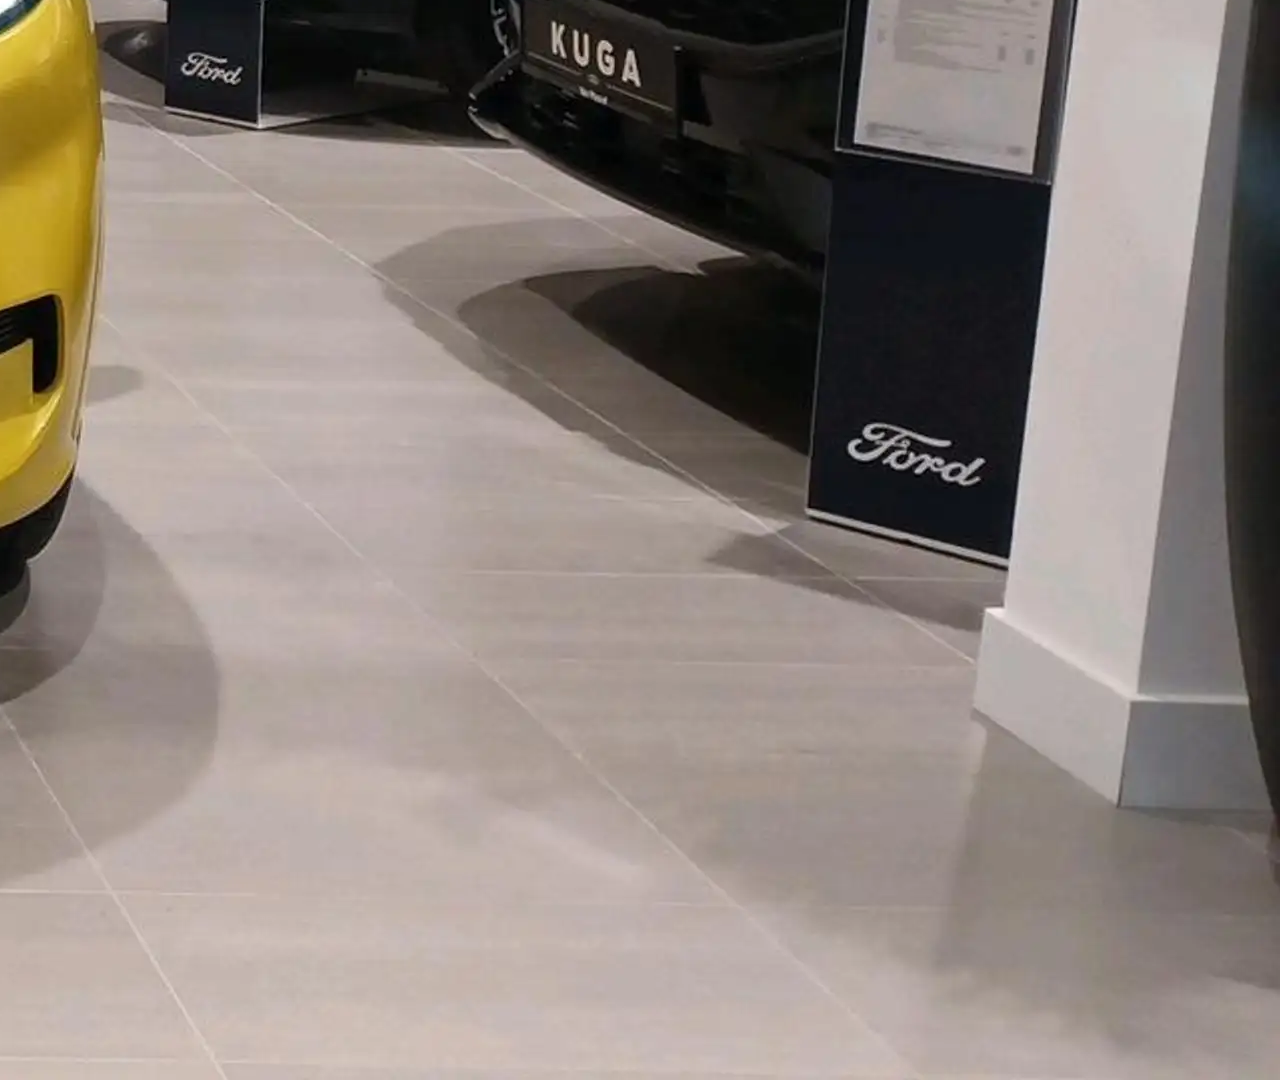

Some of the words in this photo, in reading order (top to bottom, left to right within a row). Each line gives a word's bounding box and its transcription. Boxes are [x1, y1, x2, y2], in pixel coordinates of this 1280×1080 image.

[181, 51, 244, 85] Ford
[551, 20, 642, 88] KUGA
[847, 422, 986, 486] Ford
